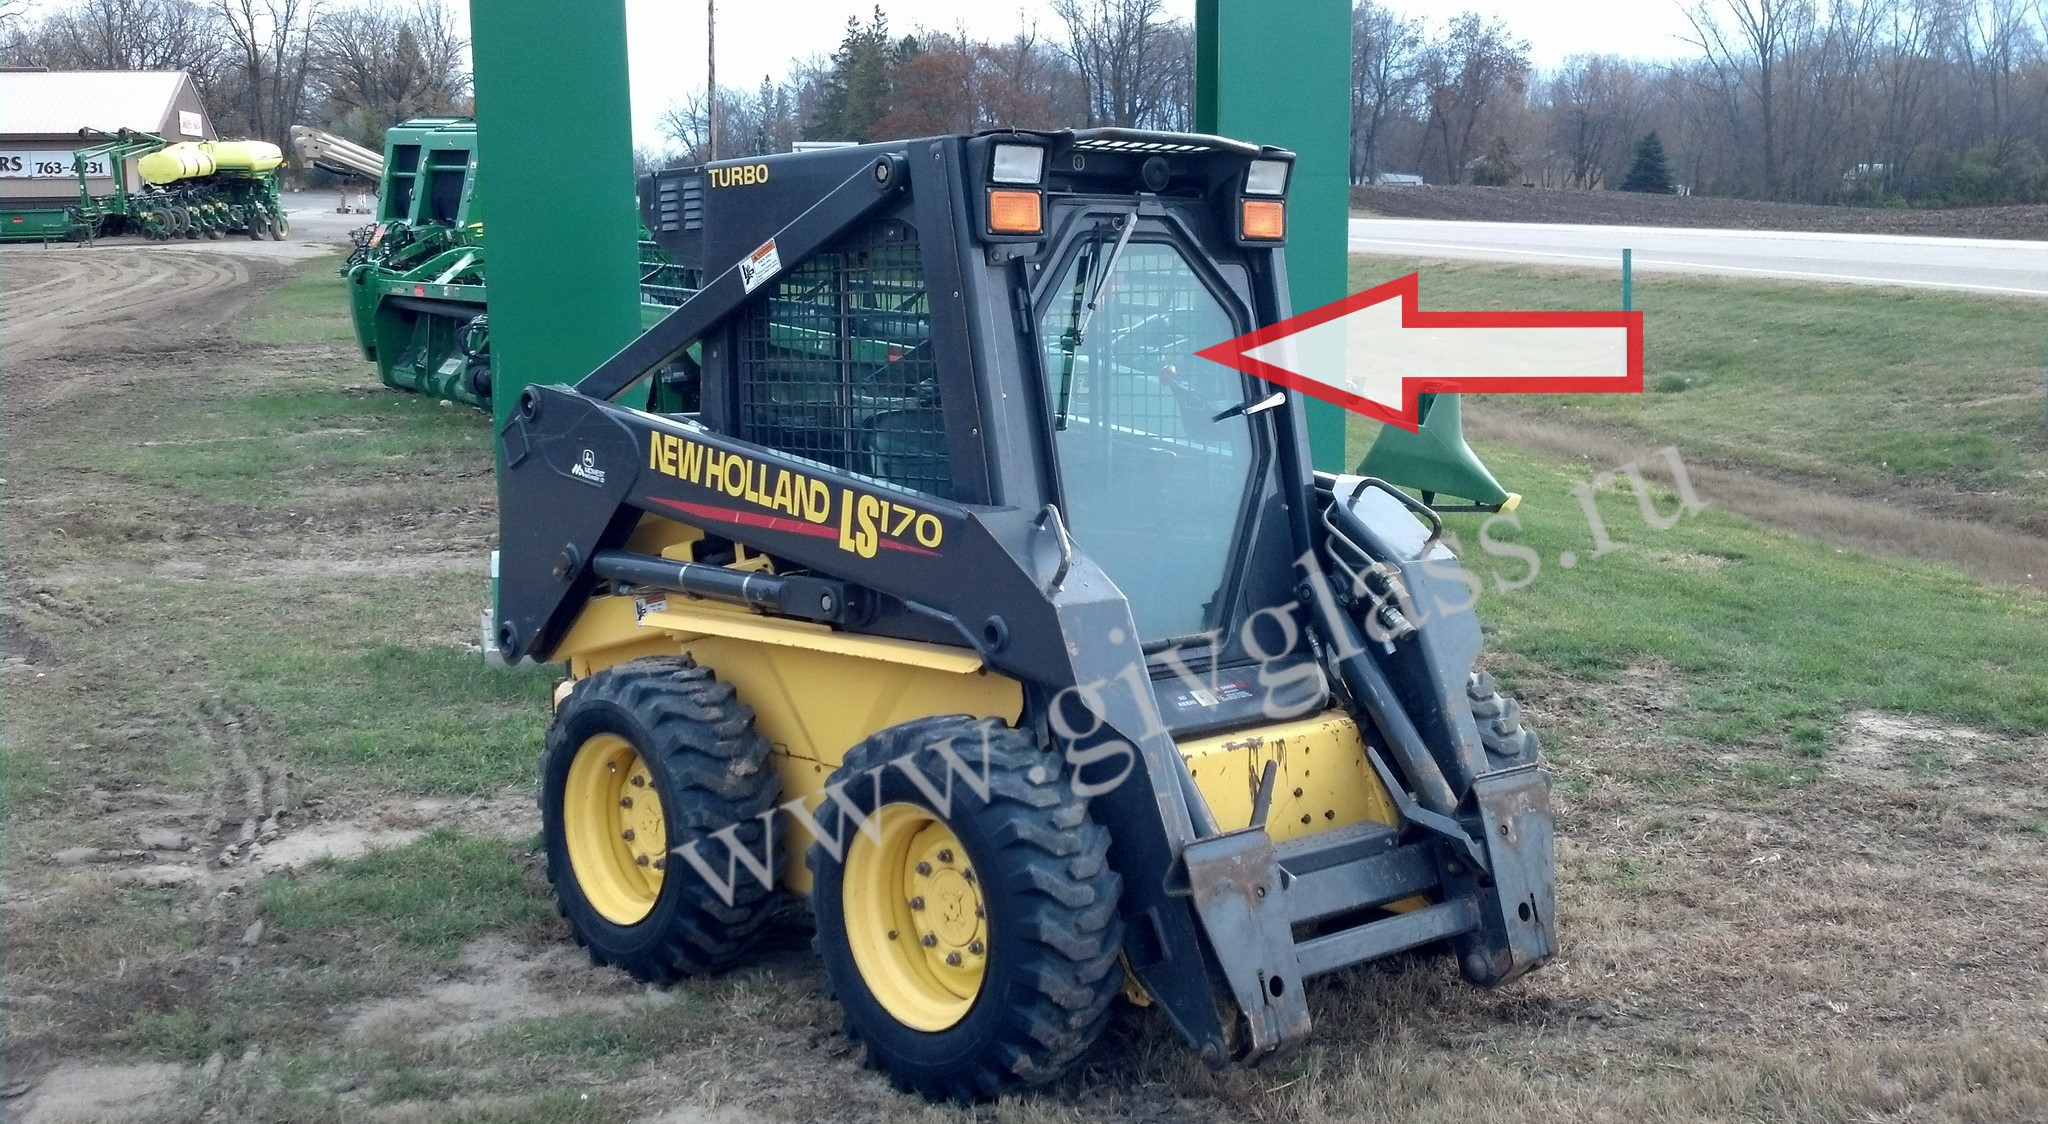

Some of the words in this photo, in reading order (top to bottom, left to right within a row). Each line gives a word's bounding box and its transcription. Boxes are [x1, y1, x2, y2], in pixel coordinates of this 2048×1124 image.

[708, 163, 769, 188] TURBO
[649, 430, 704, 484] NEW
[705, 447, 831, 524] HOLLAND
